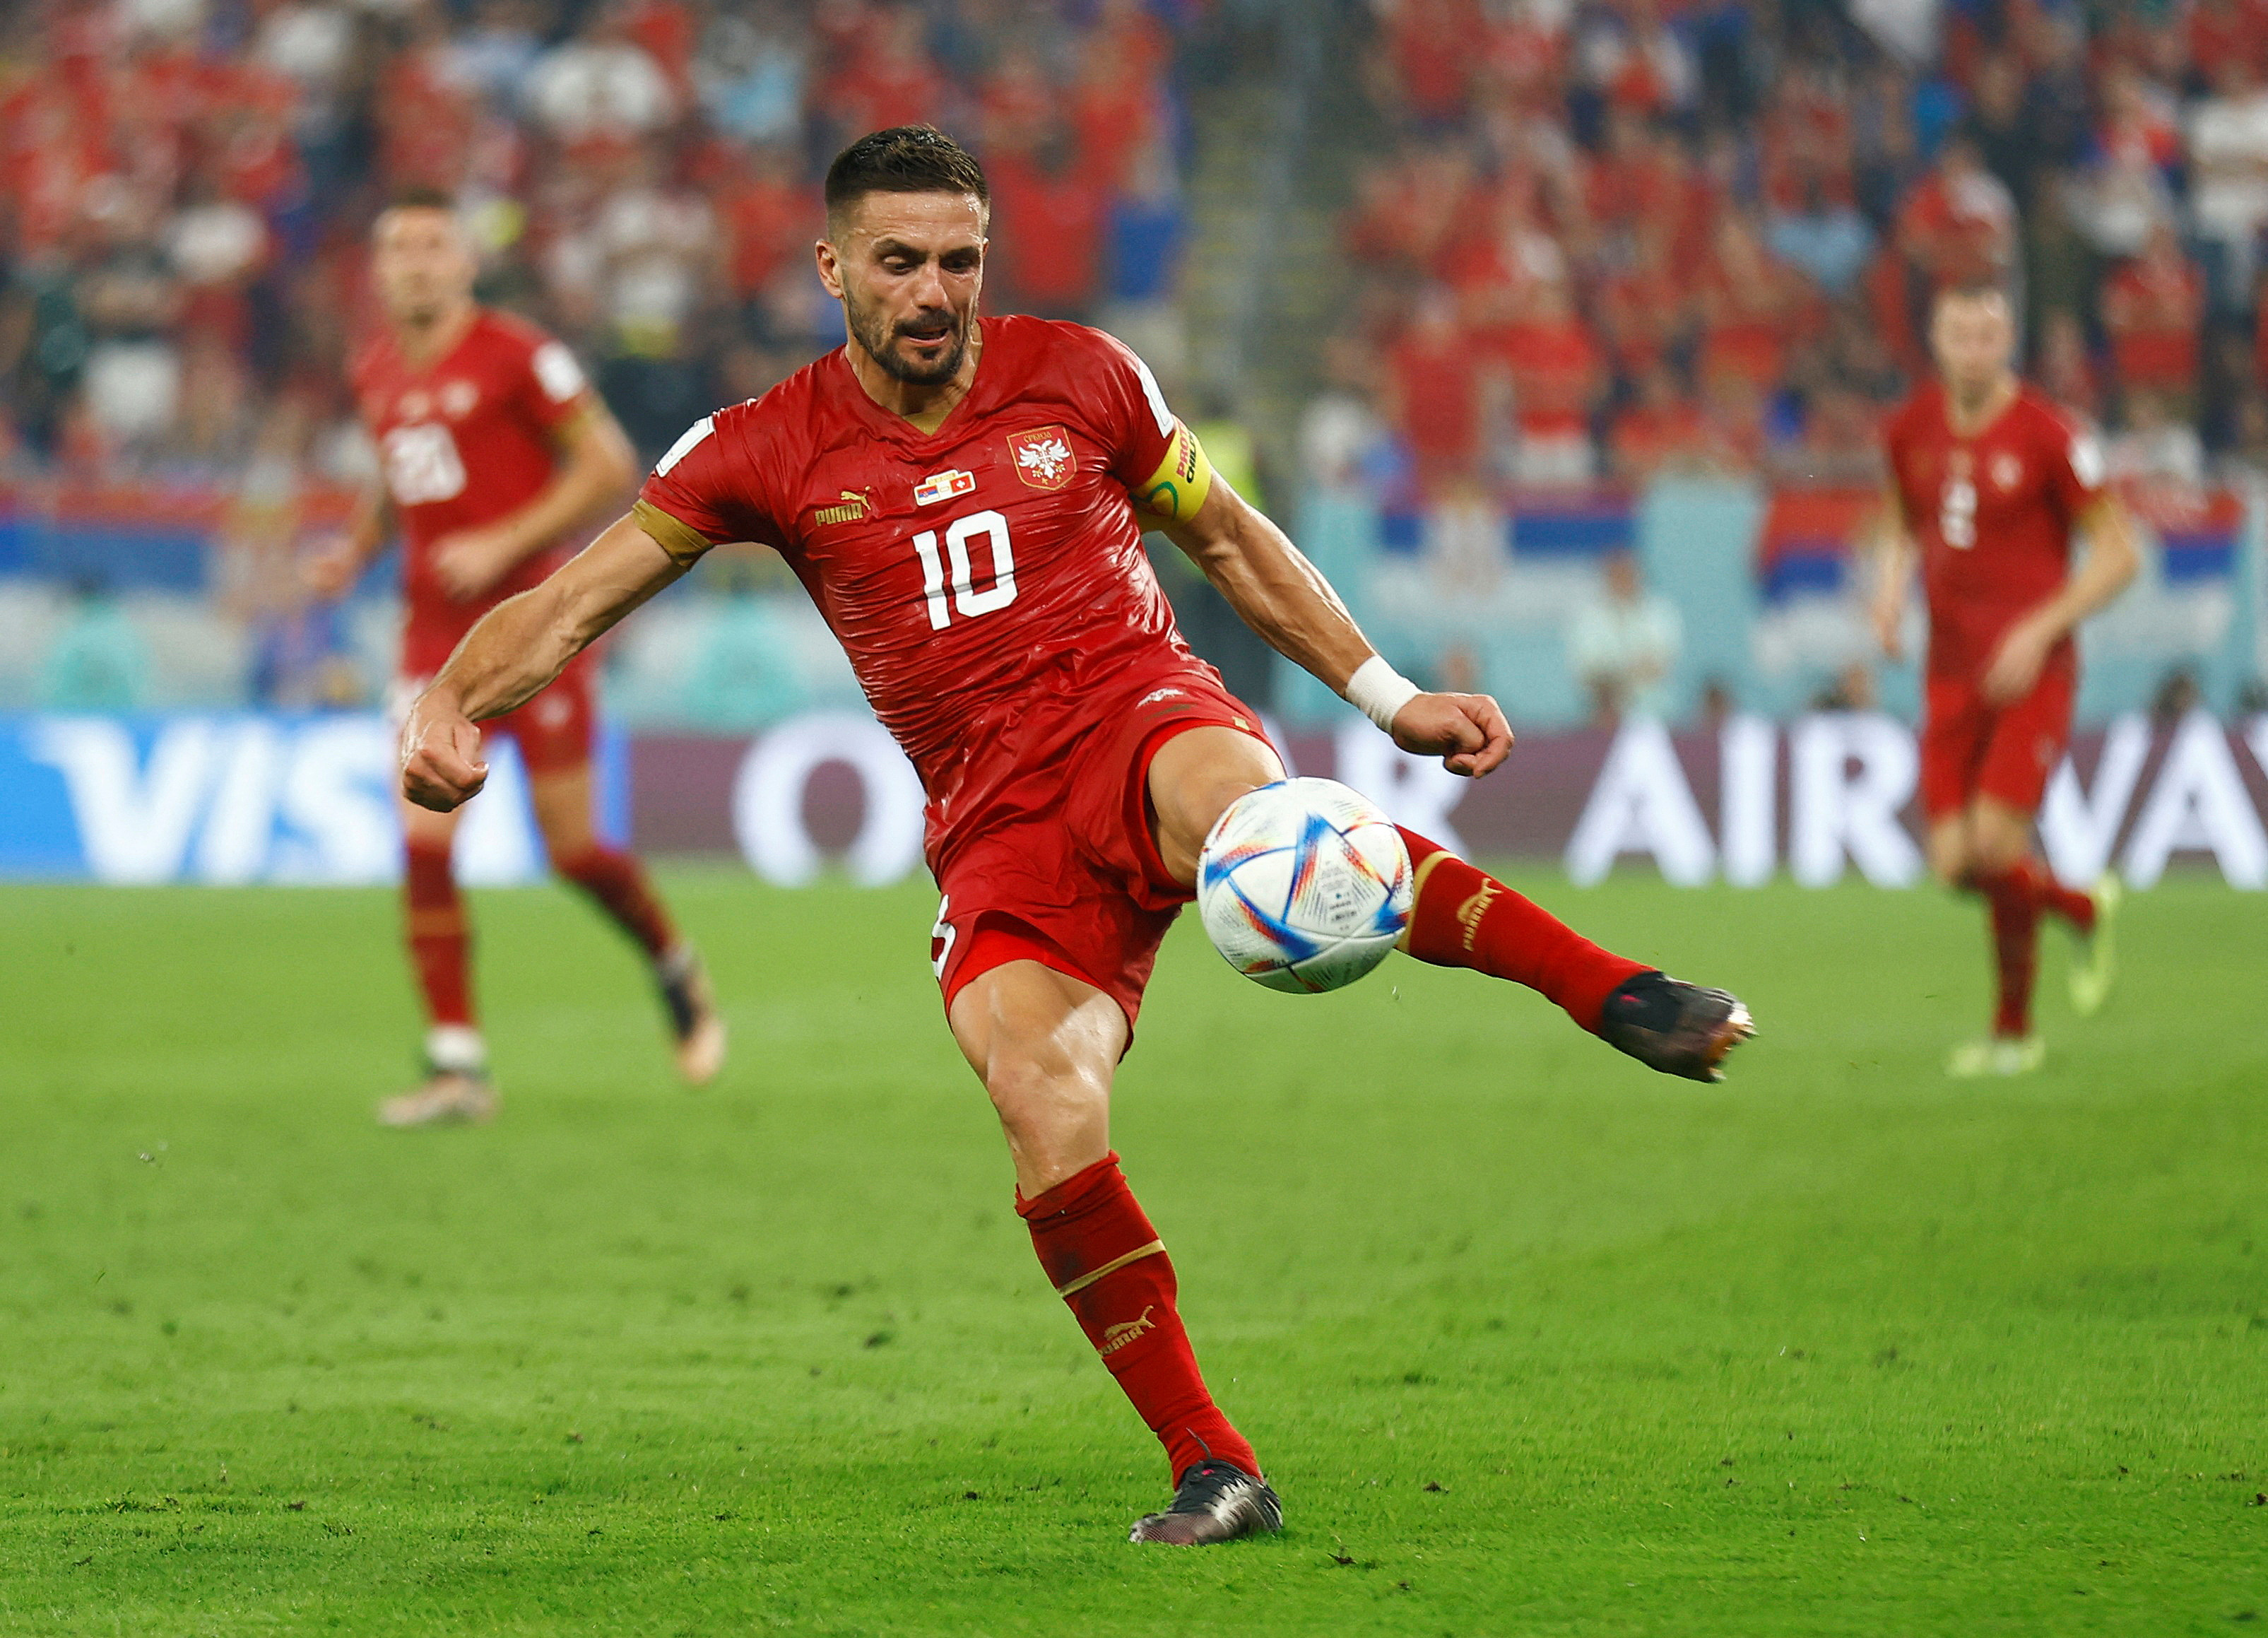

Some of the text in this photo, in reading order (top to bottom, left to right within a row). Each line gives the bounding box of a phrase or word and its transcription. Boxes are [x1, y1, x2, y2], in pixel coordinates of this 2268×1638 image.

[815, 502, 863, 527] PUMA
[912, 509, 1018, 630] 10
[1565, 711, 2268, 889] AIRWA
